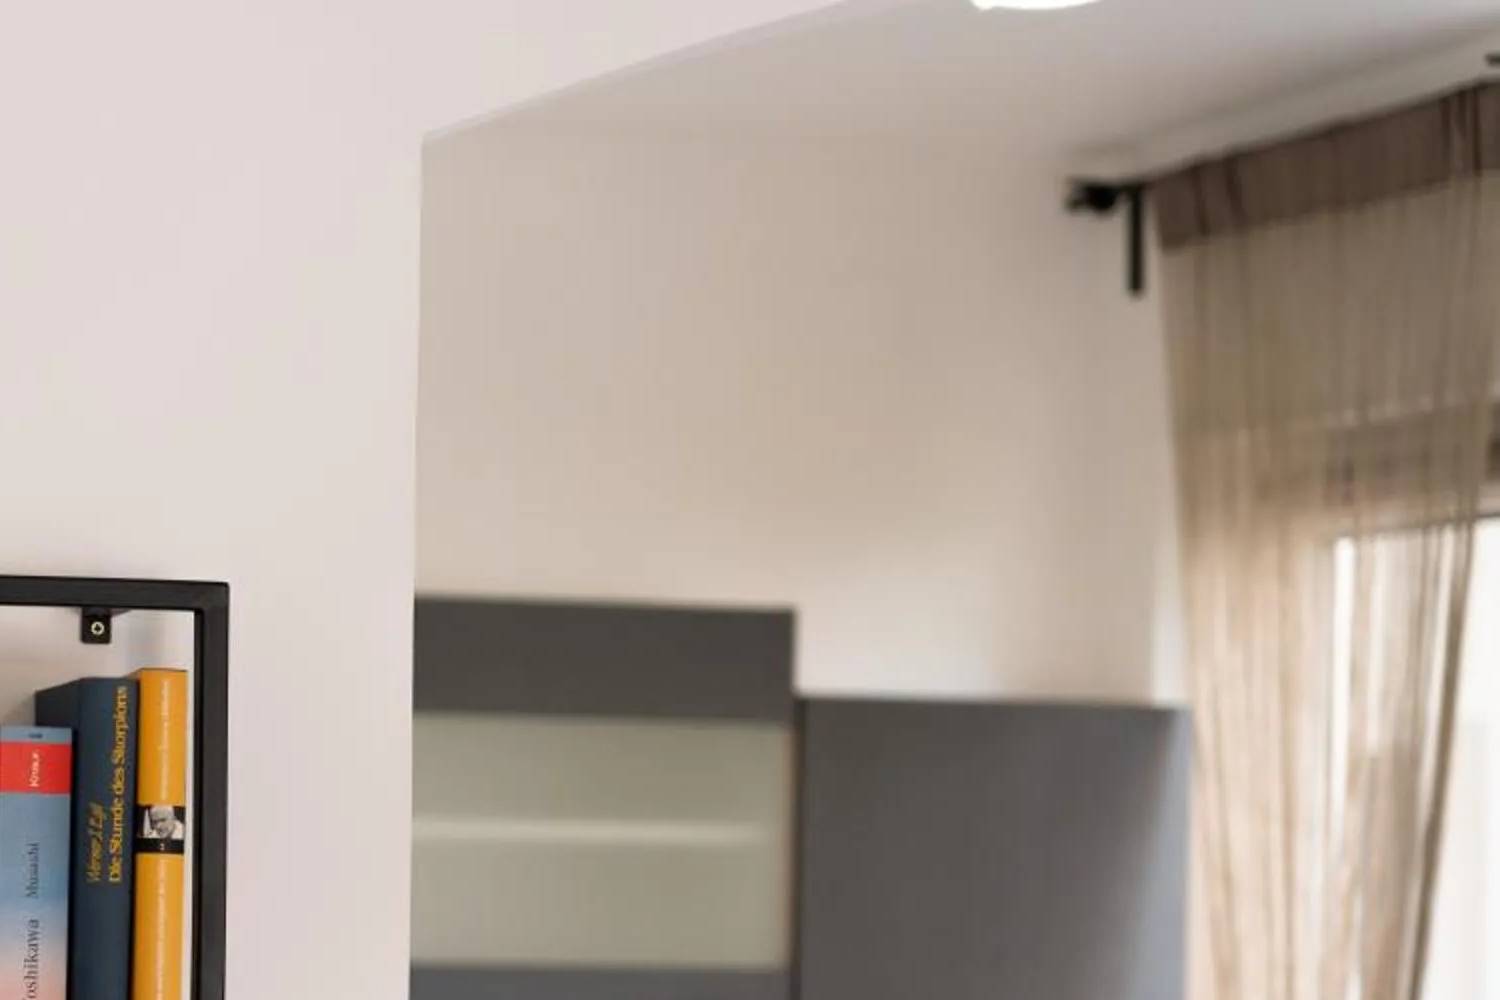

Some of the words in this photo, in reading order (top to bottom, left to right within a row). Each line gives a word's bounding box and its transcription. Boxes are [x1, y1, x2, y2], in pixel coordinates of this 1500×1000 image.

[112, 685, 129, 765] Skorpions
[111, 768, 126, 795] des
[109, 798, 124, 851] Stunde
[108, 855, 122, 883] Die
